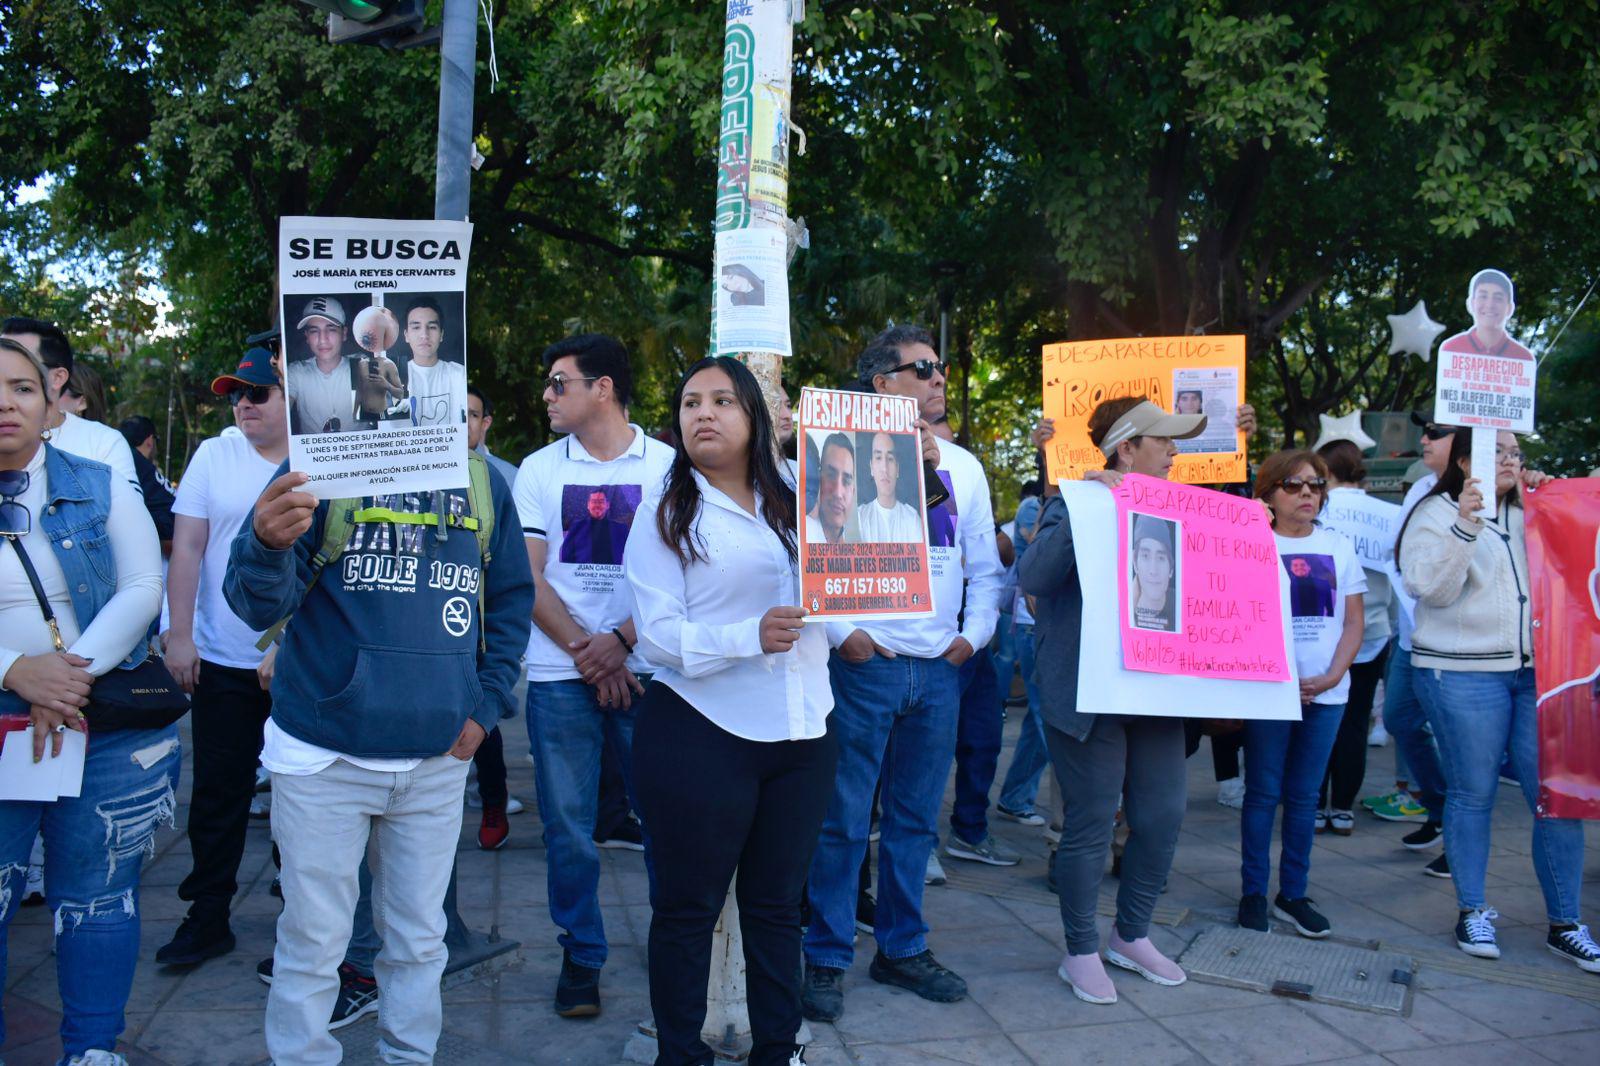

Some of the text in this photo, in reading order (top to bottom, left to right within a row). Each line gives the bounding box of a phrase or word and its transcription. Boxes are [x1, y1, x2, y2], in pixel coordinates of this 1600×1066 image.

[289, 238, 461, 260] SE BUSCA
[292, 268, 320, 278] JOSÉ
[360, 268, 394, 277] REYES
[396, 268, 456, 277] CERVANTES
[354, 279, 398, 290] (CHEMA)
[1452, 355, 1524, 376] DESAPARECIDO
[1461, 391, 1494, 405] ALBERTO
[1496, 394, 1506, 406] DE
[1448, 402, 1475, 415] IBARRA
[312, 434, 360, 444] DESCONOCE
[373, 430, 411, 440] PARADERO
[306, 446, 332, 454] LUNES
[350, 440, 394, 450] SEPTIEMBRE
[410, 438, 428, 446] 2024
[312, 454, 340, 463] NOCHE
[342, 452, 378, 460] MIENTRAS
[380, 448, 422, 458] TRABAJABA
[424, 446, 434, 454] DE
[307, 470, 348, 482] CUALQUIER
[350, 465, 401, 478] INFORMACIÓN
[402, 463, 420, 472] SERÁ
[432, 461, 458, 470] MUCHA
[808, 544, 817, 556] 09
[818, 544, 856, 556] SEPTIEMBRE
[856, 544, 873, 556] 2024
[1212, 536, 1229, 558] TE
[806, 557, 921, 573] JOSE MARIA REYES CERVANTES
[343, 554, 480, 594] CODE 1969
[1206, 572, 1226, 592] TU
[824, 576, 907, 595] 667 157 1930
[1187, 597, 1242, 620] FAMILIA
[1248, 600, 1267, 622] TE
